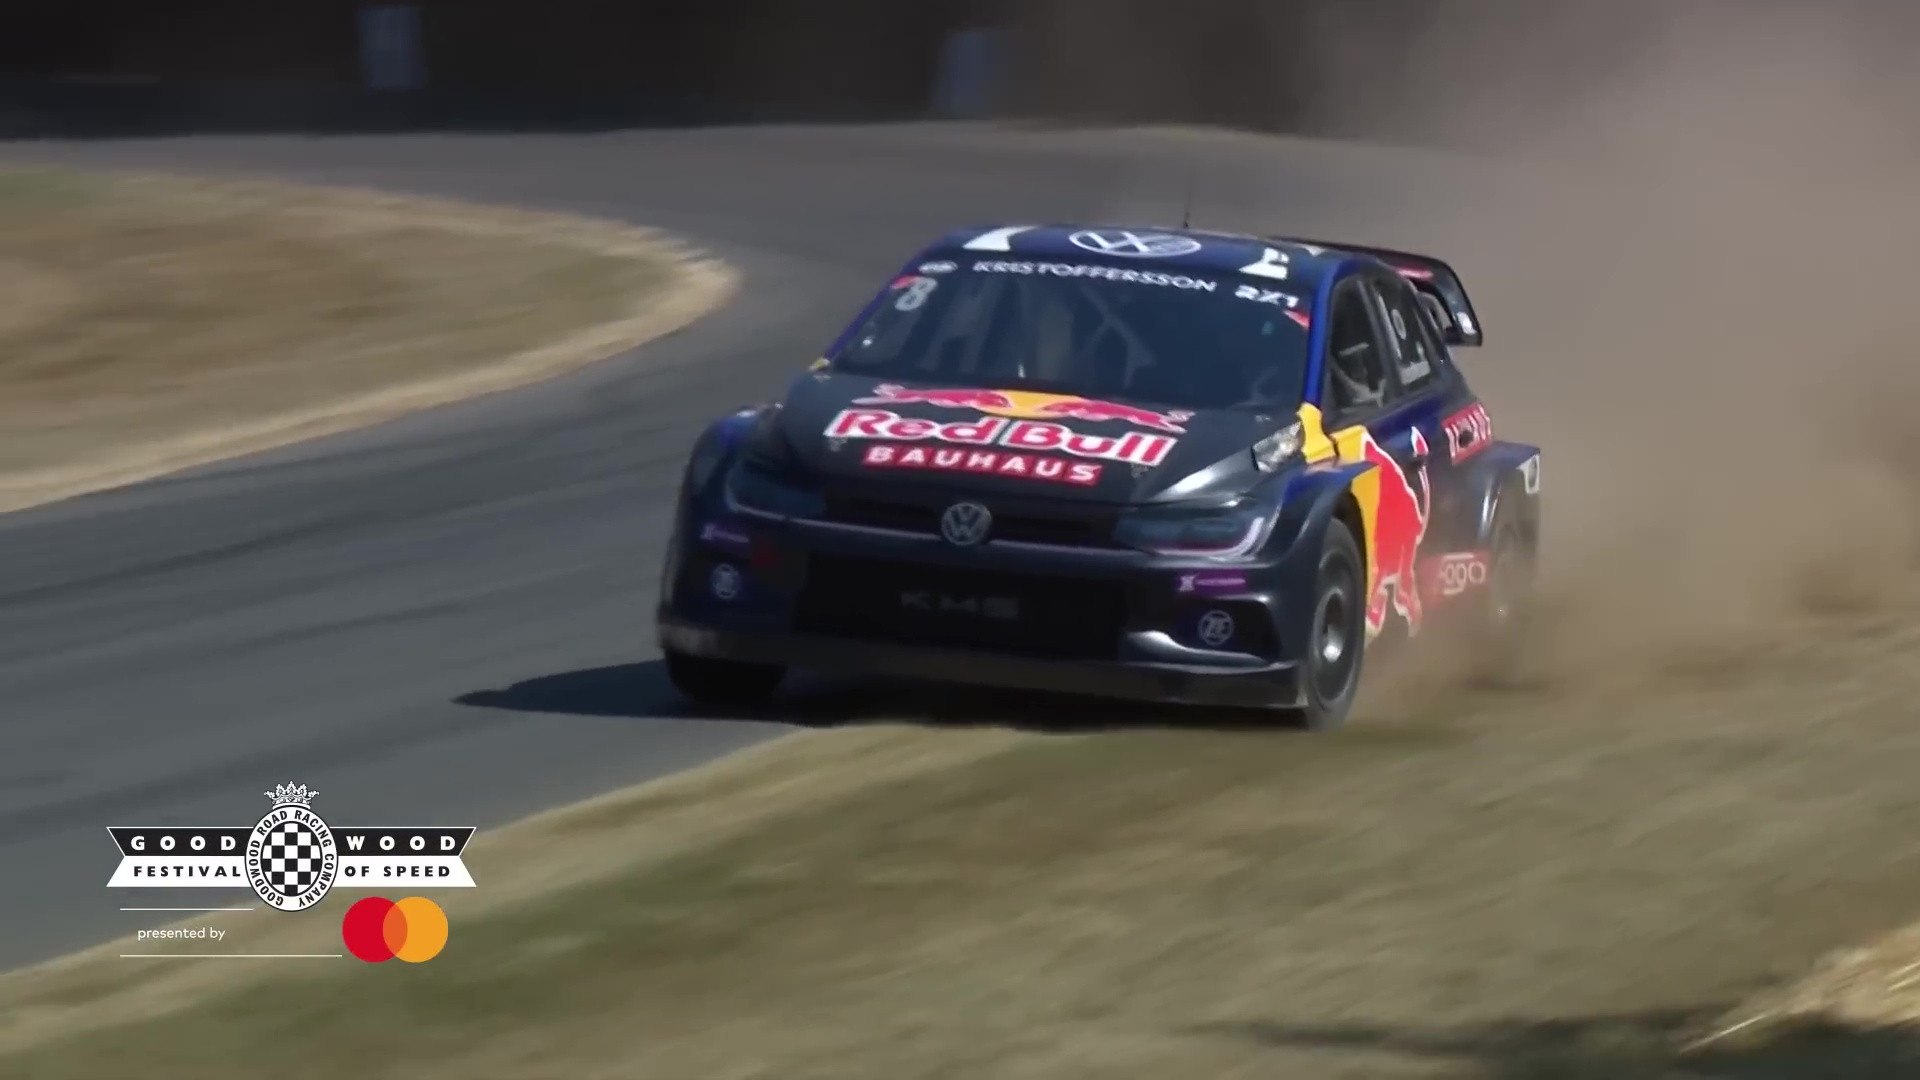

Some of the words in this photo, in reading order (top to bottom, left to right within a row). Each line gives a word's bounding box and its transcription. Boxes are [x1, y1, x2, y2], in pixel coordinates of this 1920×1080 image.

[896, 276, 938, 311] 8
[973, 260, 1217, 292] KRISTOFFERSSON
[824, 409, 1010, 444] Red
[1000, 420, 1178, 466] Bull
[866, 447, 1101, 483] BAUHAUS
